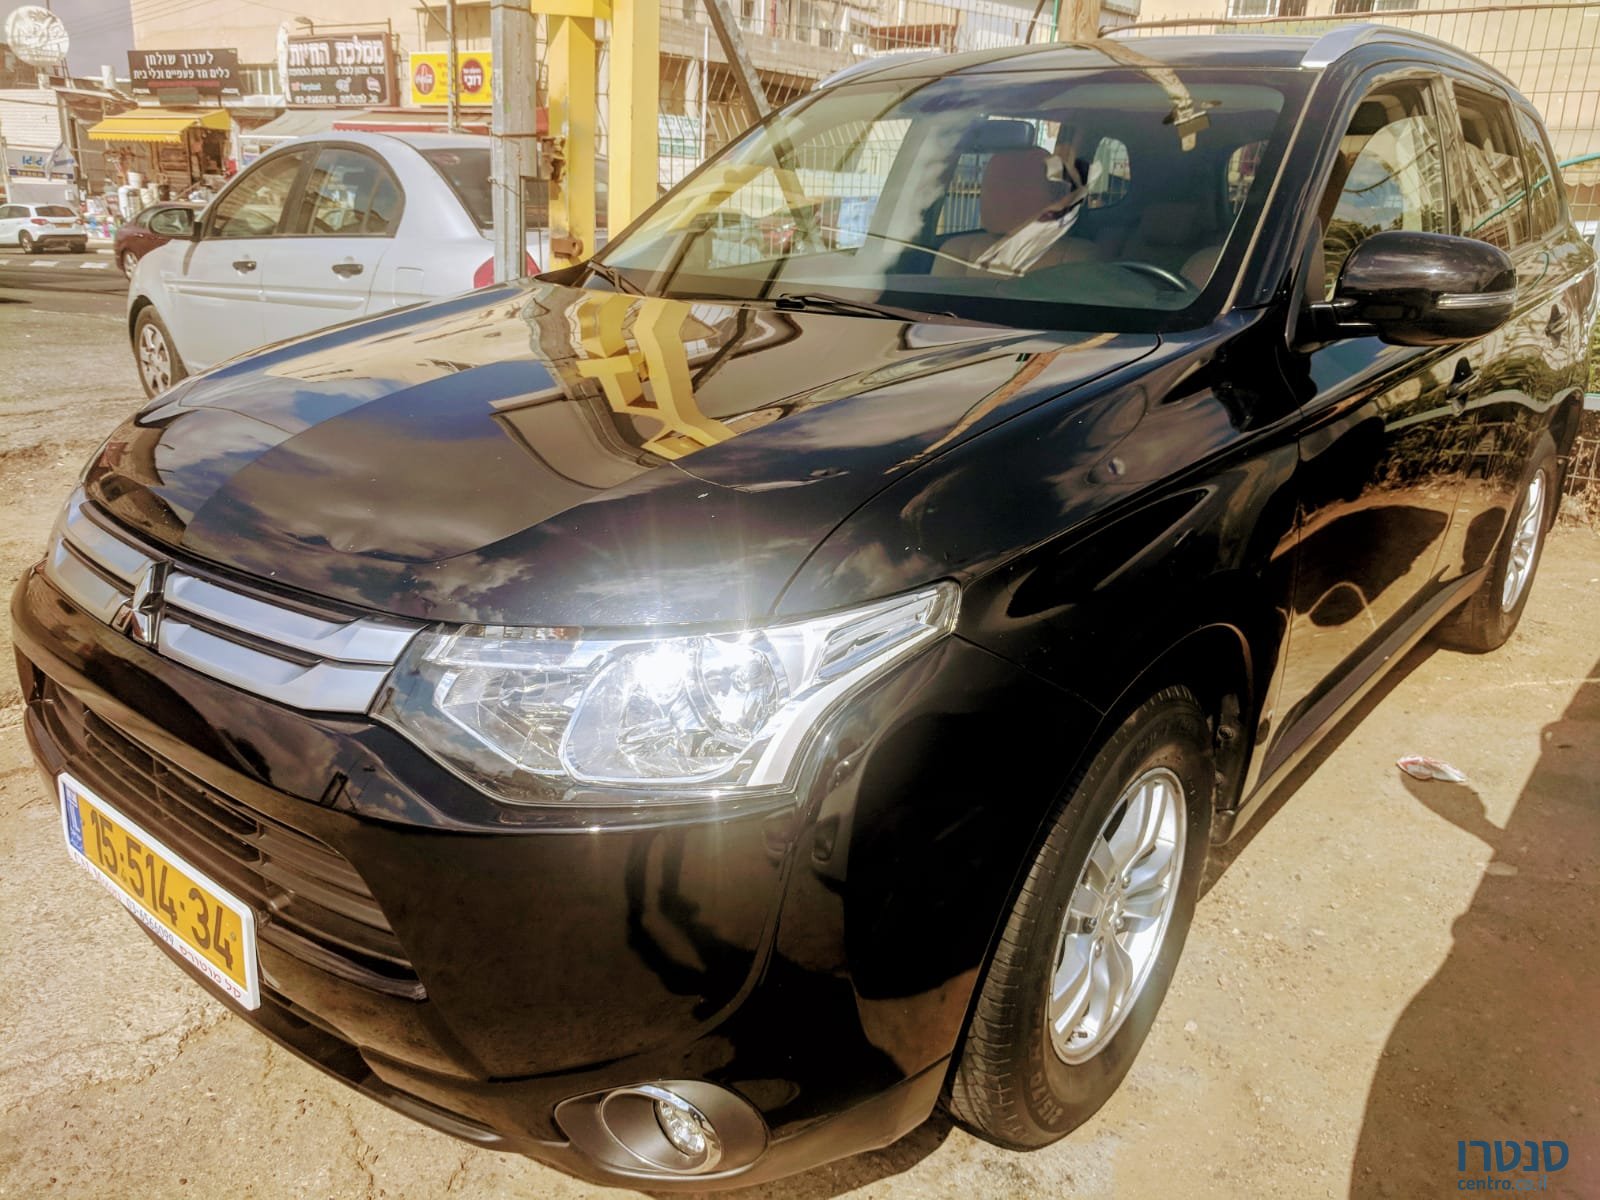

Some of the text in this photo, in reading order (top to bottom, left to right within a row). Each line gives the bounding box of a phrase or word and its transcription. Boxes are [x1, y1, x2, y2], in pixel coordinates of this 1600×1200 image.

[288, 35, 384, 66] ממלכת החיות
[145, 51, 214, 69] לערוך שולחן
[210, 67, 230, 79] כלים
